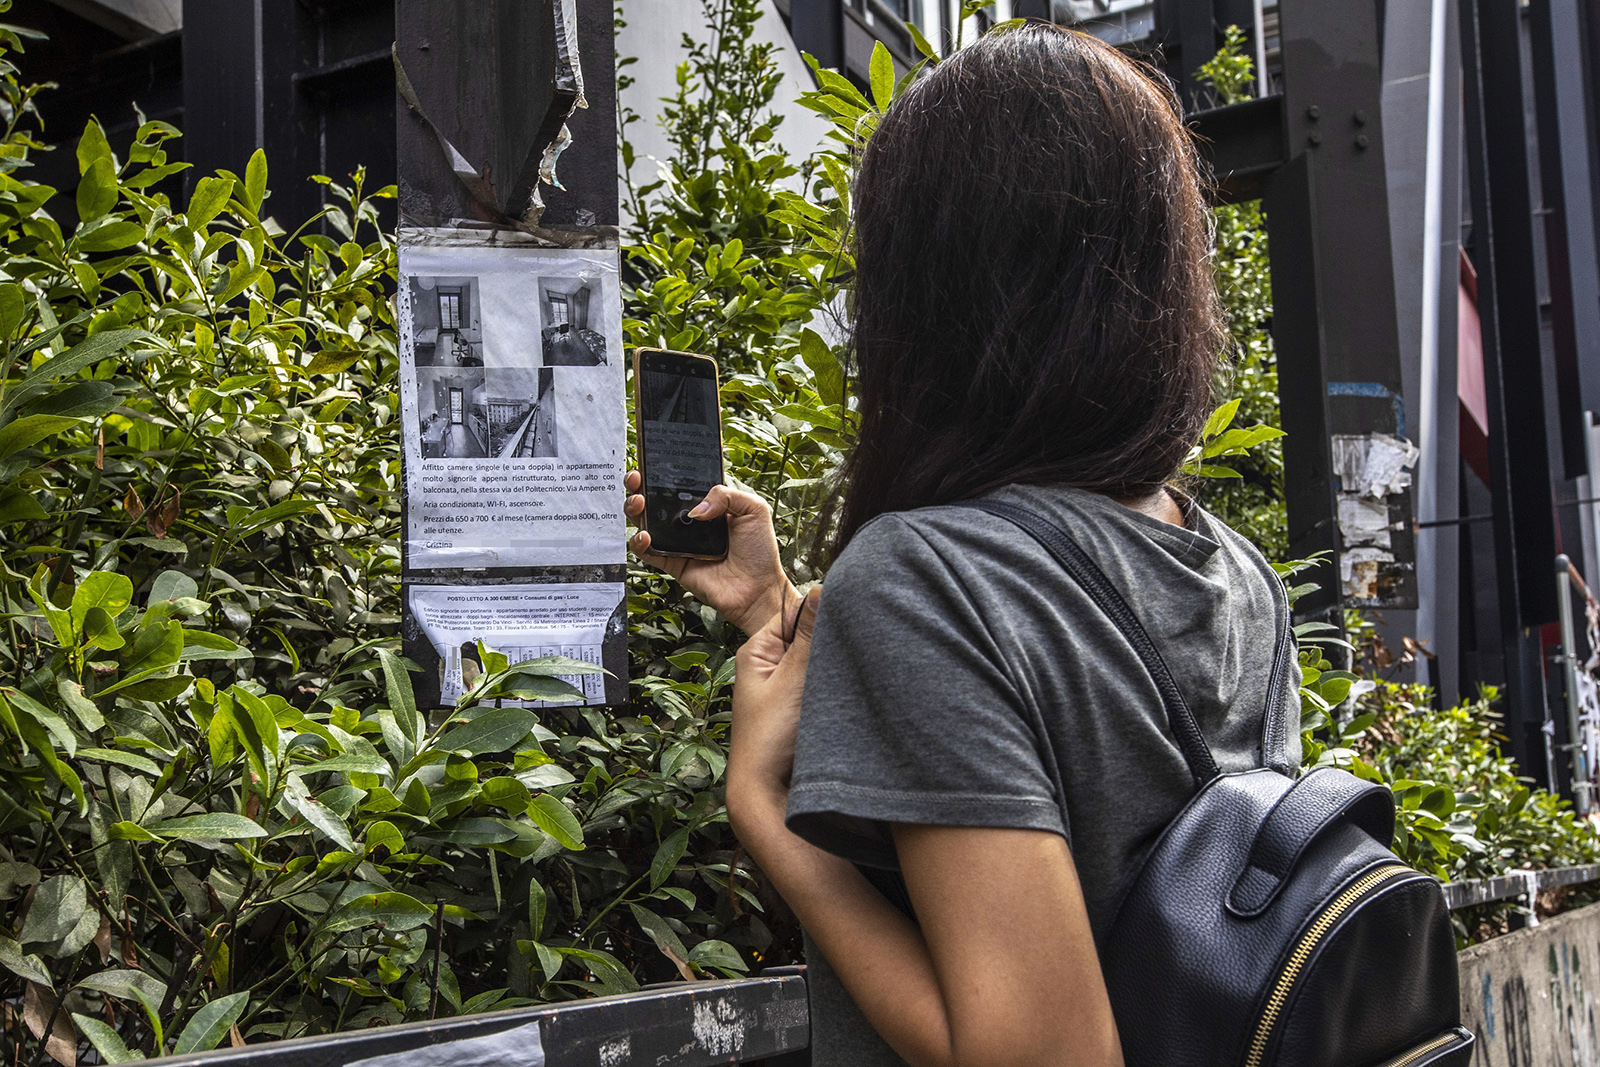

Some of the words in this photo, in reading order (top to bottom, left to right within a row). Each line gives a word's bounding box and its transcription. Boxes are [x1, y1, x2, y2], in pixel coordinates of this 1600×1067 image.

[422, 463, 444, 471] Affitto
[475, 463, 500, 472] singole
[502, 463, 510, 472] (e
[528, 463, 555, 471] doppia)
[566, 463, 615, 471] appartamento
[448, 475, 477, 483] signorile
[561, 474, 581, 482] piano
[584, 473, 598, 481] alto
[423, 486, 459, 494] balconata,
[525, 485, 565, 493] Politecnico:
[578, 484, 606, 493] Ampere
[607, 484, 616, 492] 49
[439, 501, 486, 509] condizionata,
[487, 500, 508, 508] WI-FI,
[424, 515, 444, 523] Prezzi
[445, 515, 454, 523] da
[497, 514, 504, 522] al
[524, 514, 553, 522] (camera
[554, 513, 578, 522] doppia
[578, 512, 600, 521] 800€),
[601, 512, 618, 520] oltre
